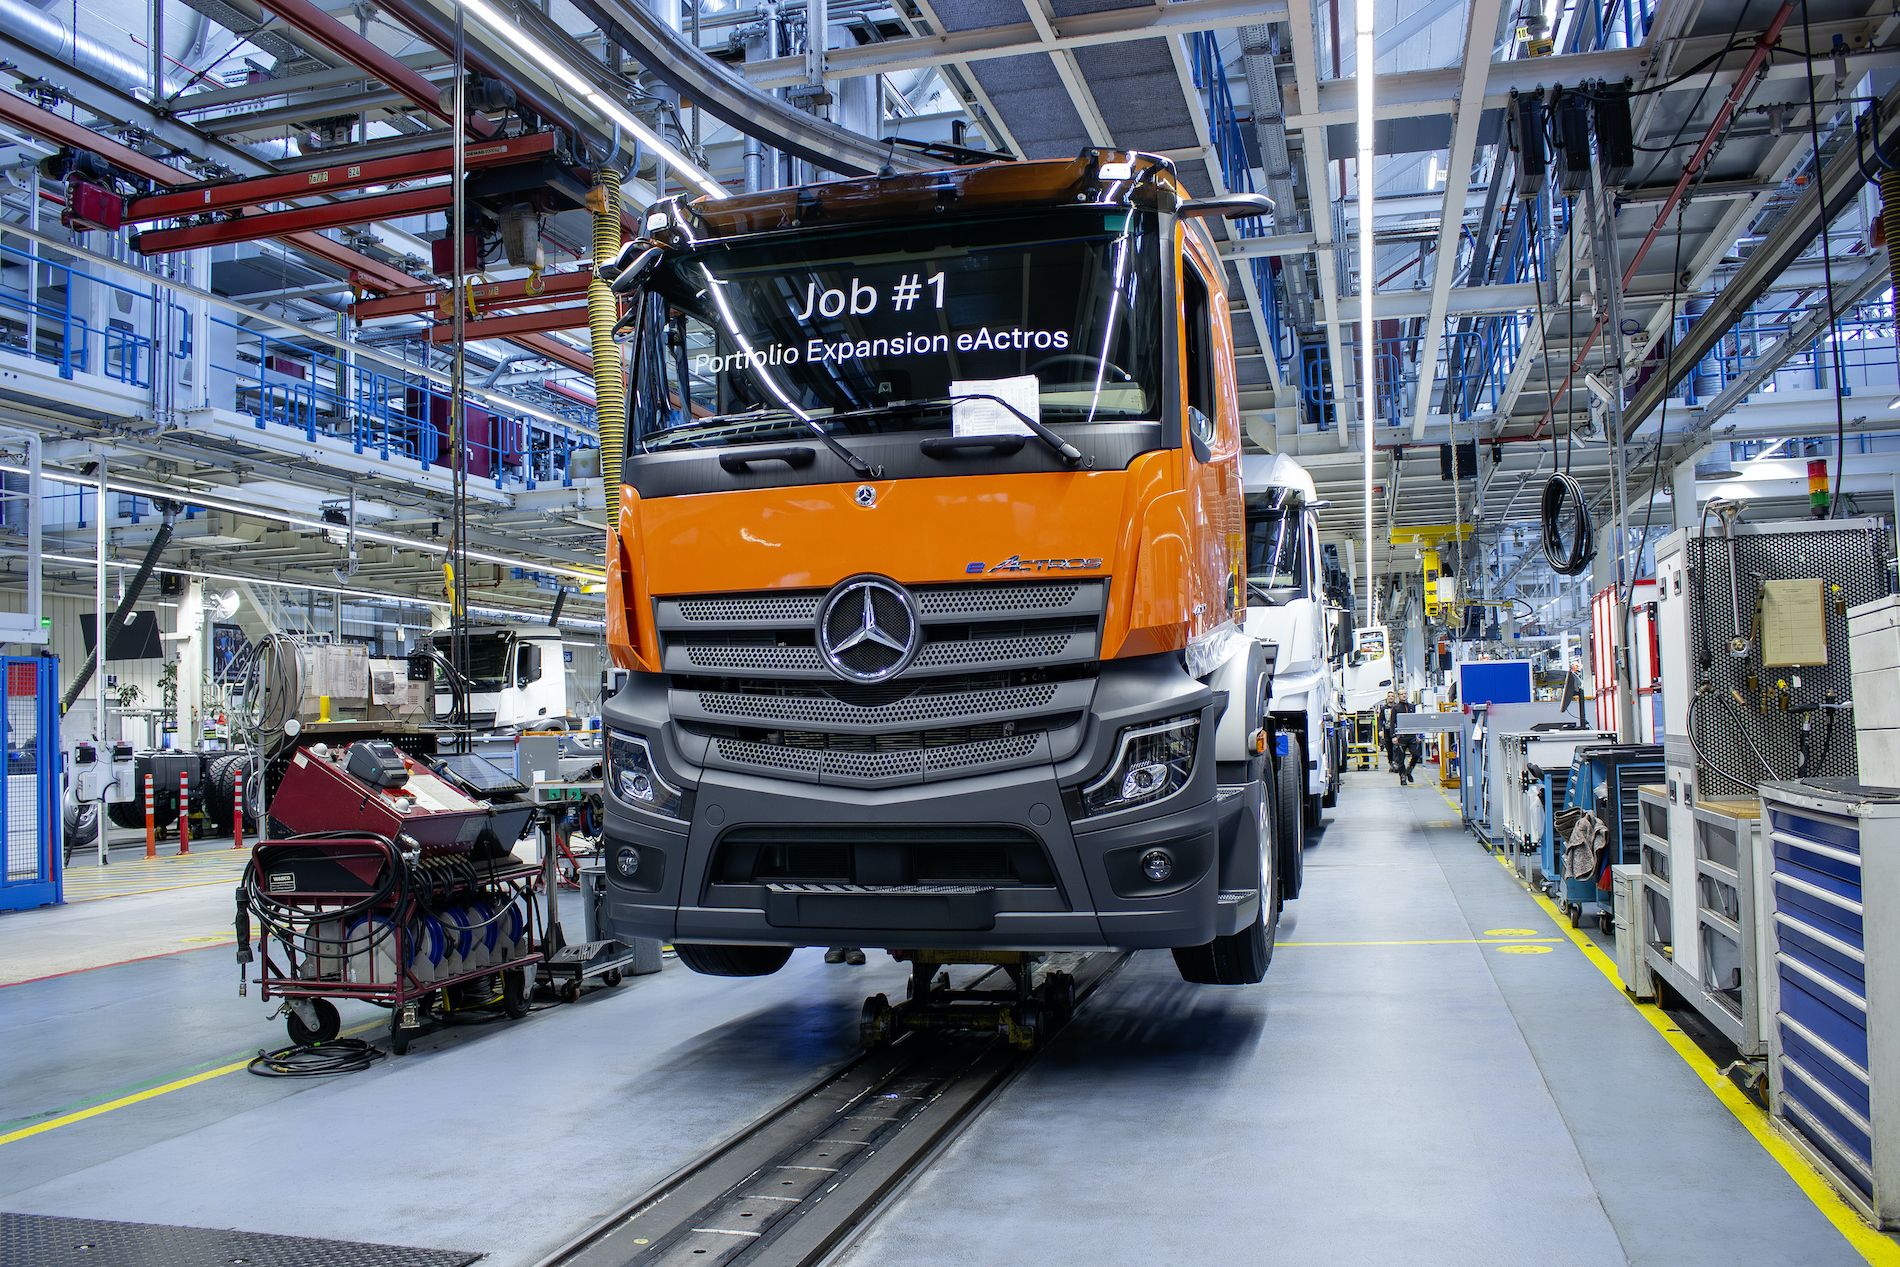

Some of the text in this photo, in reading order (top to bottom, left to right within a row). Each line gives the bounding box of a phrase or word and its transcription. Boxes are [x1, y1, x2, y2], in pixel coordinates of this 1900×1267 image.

[798, 272, 945, 320] Job #1
[694, 328, 1069, 375] Portfolio Expansion eActros
